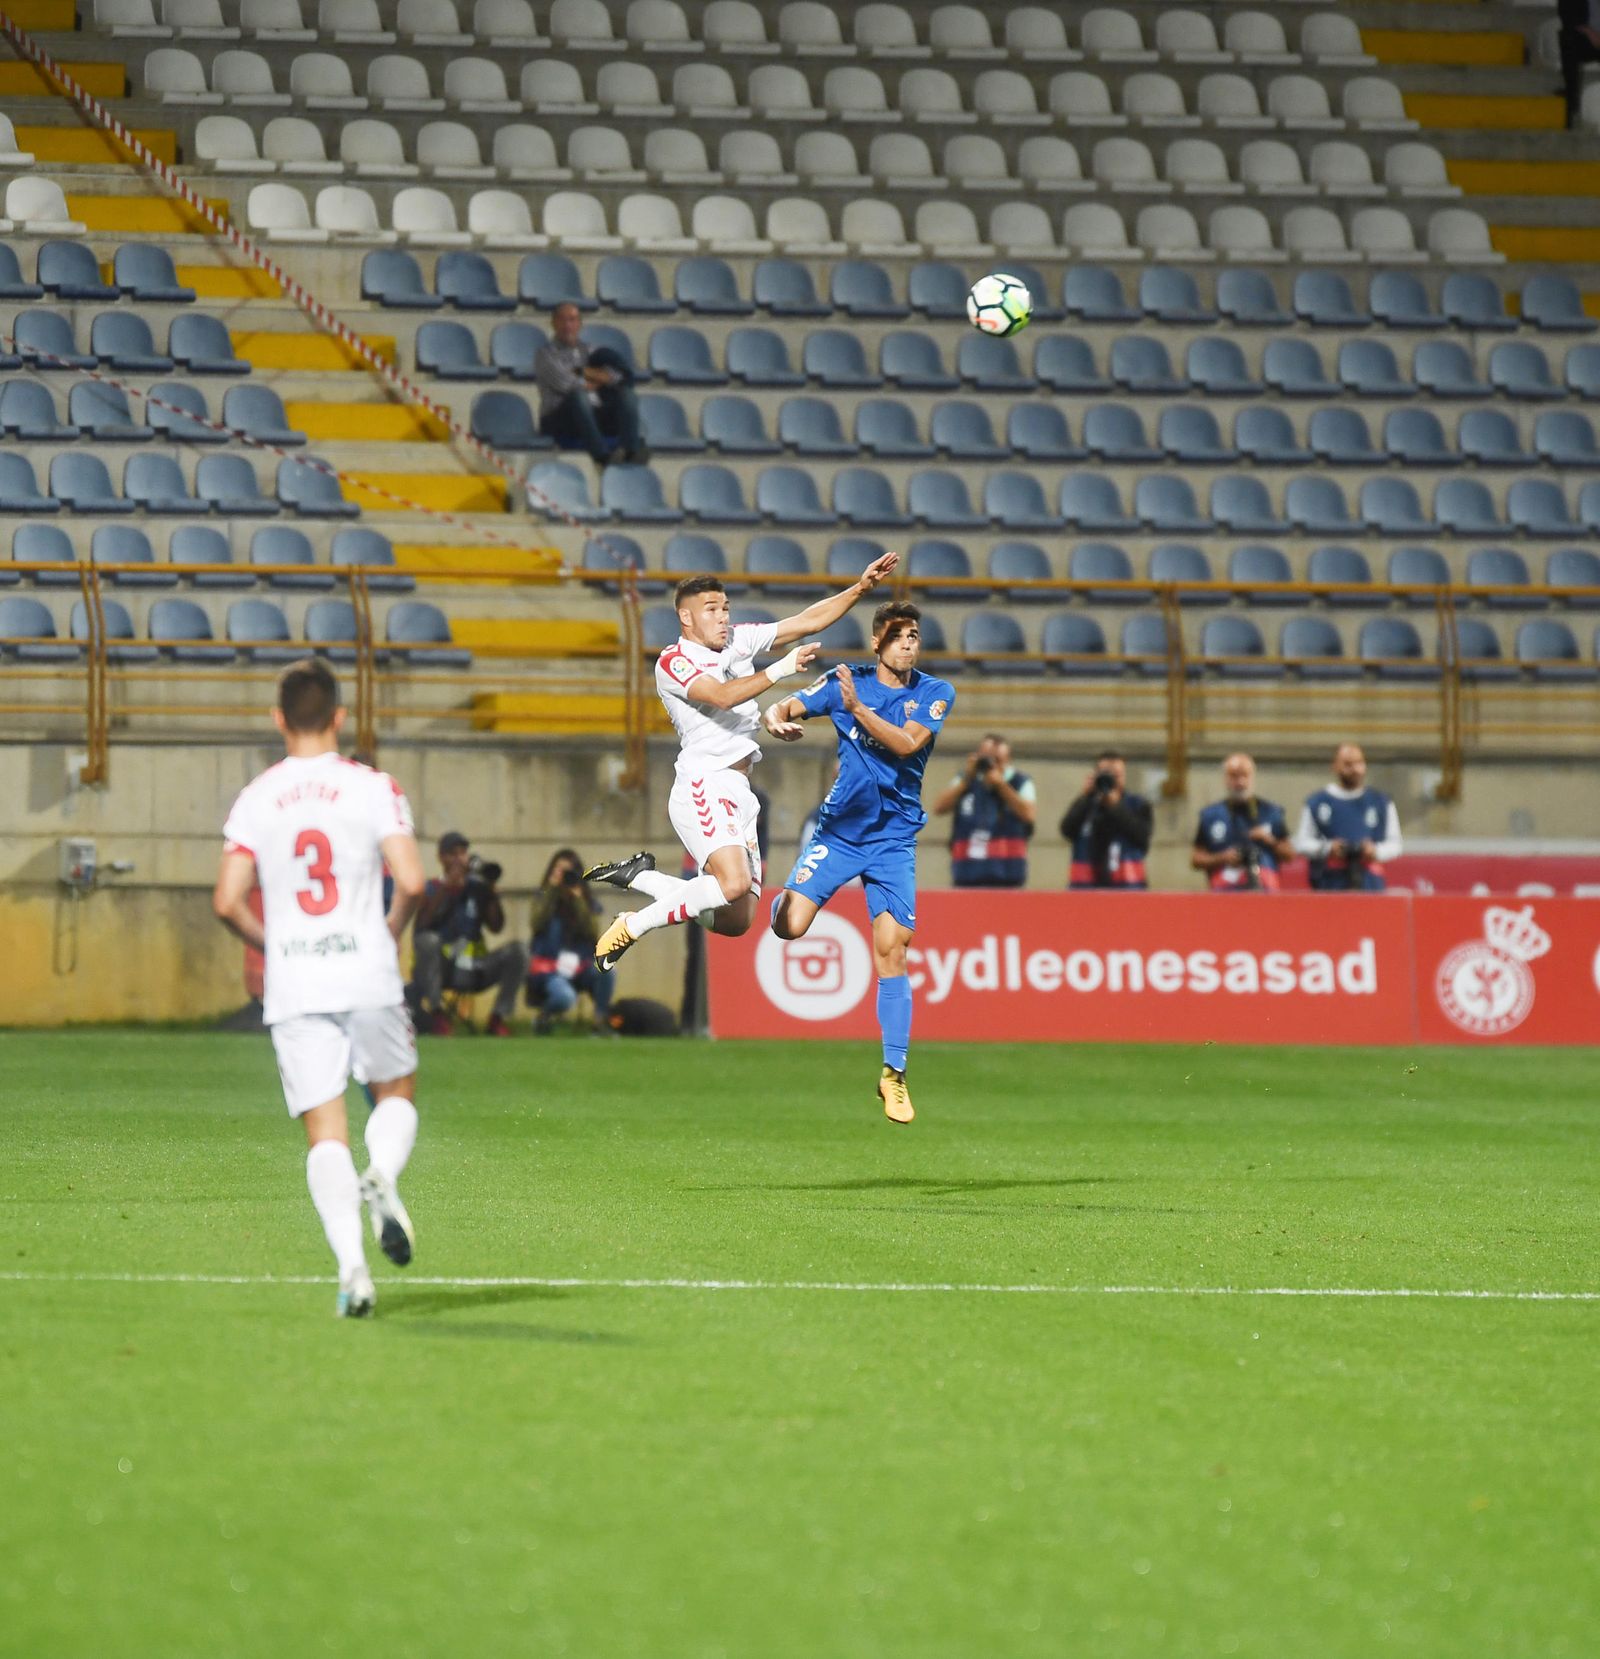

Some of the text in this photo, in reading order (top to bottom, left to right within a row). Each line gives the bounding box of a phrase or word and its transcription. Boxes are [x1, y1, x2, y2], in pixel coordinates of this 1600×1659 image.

[295, 829, 339, 916] 3
[803, 844, 829, 870] 2
[906, 934, 1377, 1003] cydleonesasad
